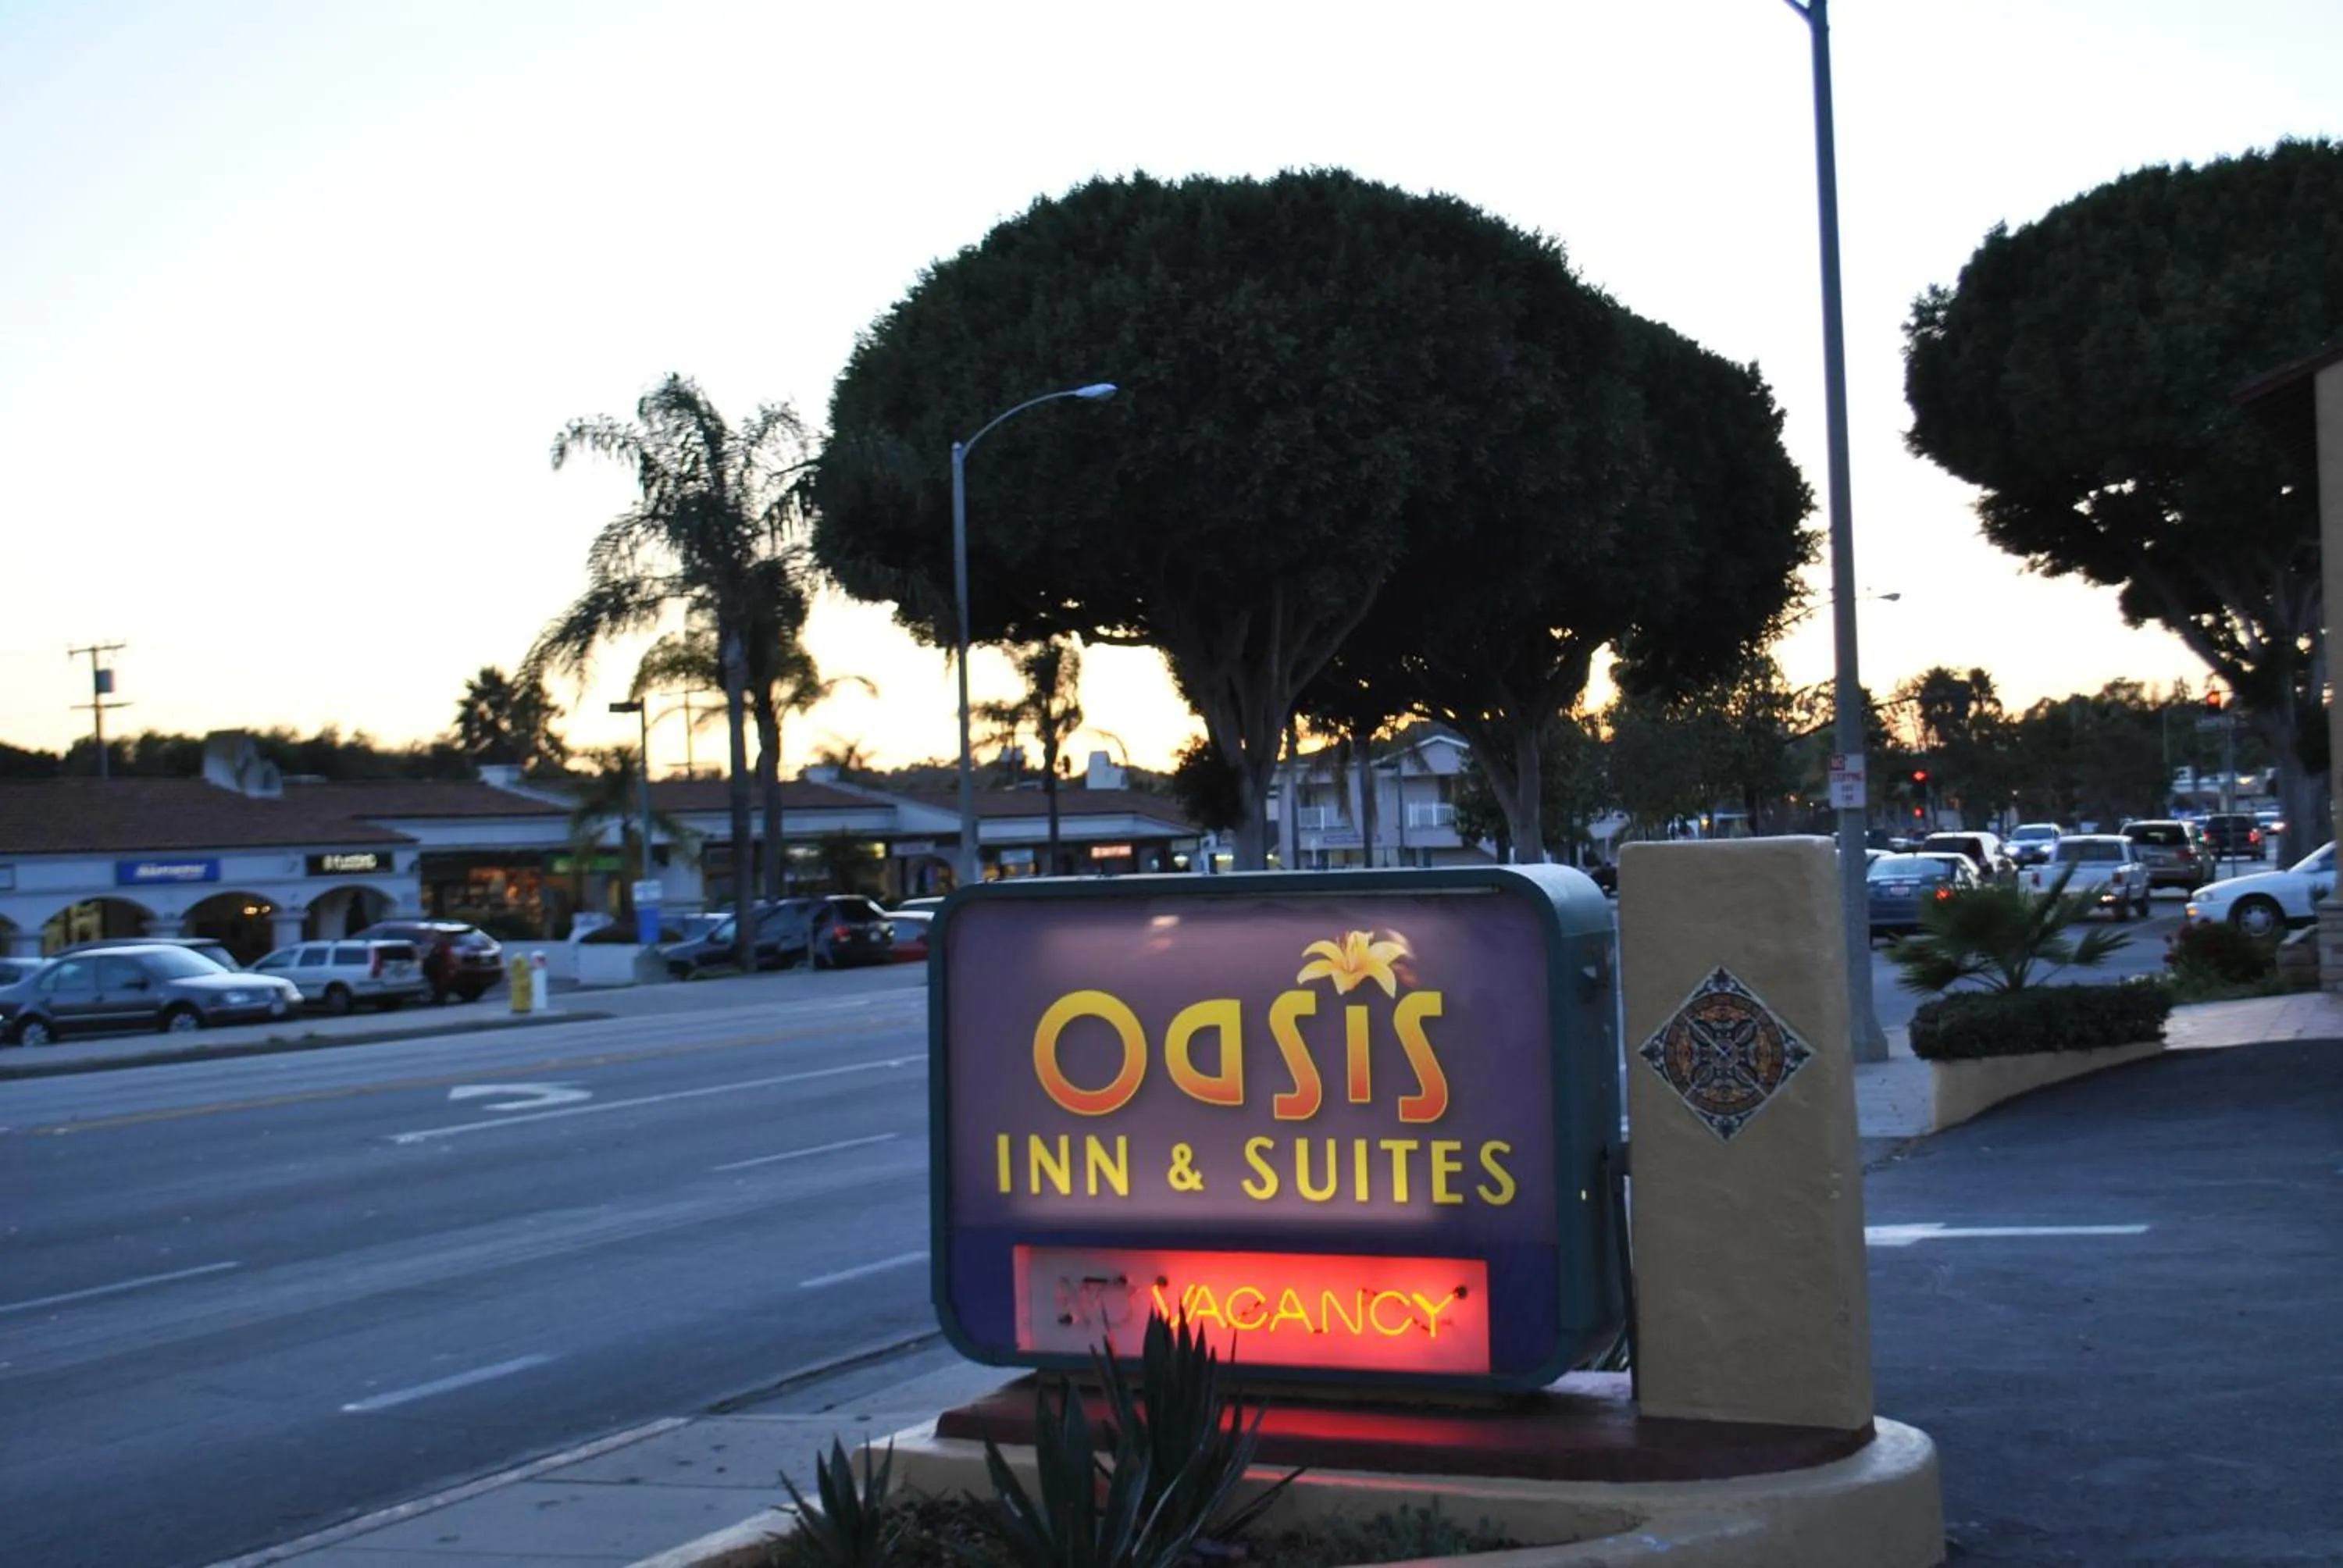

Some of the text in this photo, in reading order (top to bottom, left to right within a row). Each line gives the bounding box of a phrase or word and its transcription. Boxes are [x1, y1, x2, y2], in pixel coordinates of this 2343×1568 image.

[997, 1134, 1517, 1206] INN & SUITES
[1150, 1282, 1457, 1338] VACANCY
